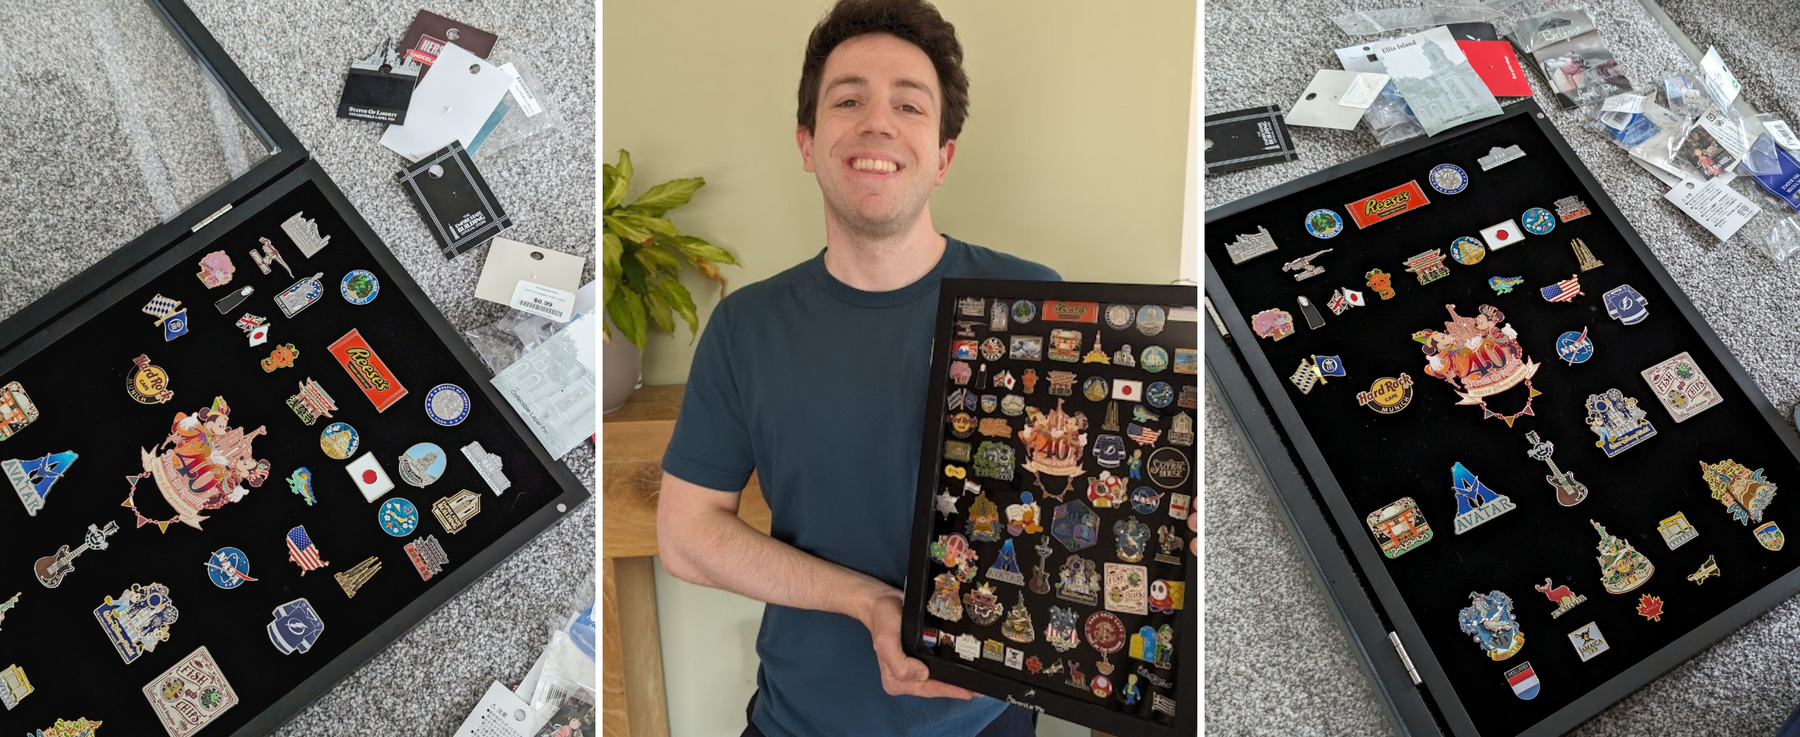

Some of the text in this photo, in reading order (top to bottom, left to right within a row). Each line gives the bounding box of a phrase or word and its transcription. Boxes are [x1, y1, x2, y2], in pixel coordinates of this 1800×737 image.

[1537, 24, 1582, 42] Belfast
[1381, 39, 1417, 54] Ellis Island
[1441, 114, 1463, 124] Collectible
[1261, 120, 1274, 144] BUILDING
[1365, 189, 1410, 216] Reese's
[457, 214, 485, 232] BUILDING
[532, 297, 553, 307] $6.99
[1559, 338, 1590, 355] NASA
[1459, 339, 1507, 377] 40
[133, 354, 173, 403] Hard Rock
[345, 349, 390, 393] Reese's
[1657, 372, 1675, 392] FISH
[127, 377, 146, 402] MUNICH
[139, 378, 149, 391] CAFE
[1357, 373, 1412, 404] Hard Rock
[1686, 379, 1704, 398] CHIPS
[1380, 396, 1409, 412] MUNICH
[1384, 392, 1398, 402] CAFE
[510, 388, 549, 435] Collectible Lapel Pin
[177, 444, 224, 493] 40
[3, 458, 41, 512] AVATAR
[436, 502, 458, 529] BUILDING
[1454, 496, 1511, 530] AVATAR
[216, 551, 241, 585] NASA
[986, 569, 1023, 583] AVATAR
[1552, 595, 1585, 617] EXMOOR
[1643, 602, 1659, 613] CANADA
[1577, 637, 1603, 657] JAMAICA
[180, 663, 208, 686] FISH
[1507, 663, 1528, 677] HOLLAND
[174, 699, 201, 723] CHIPS
